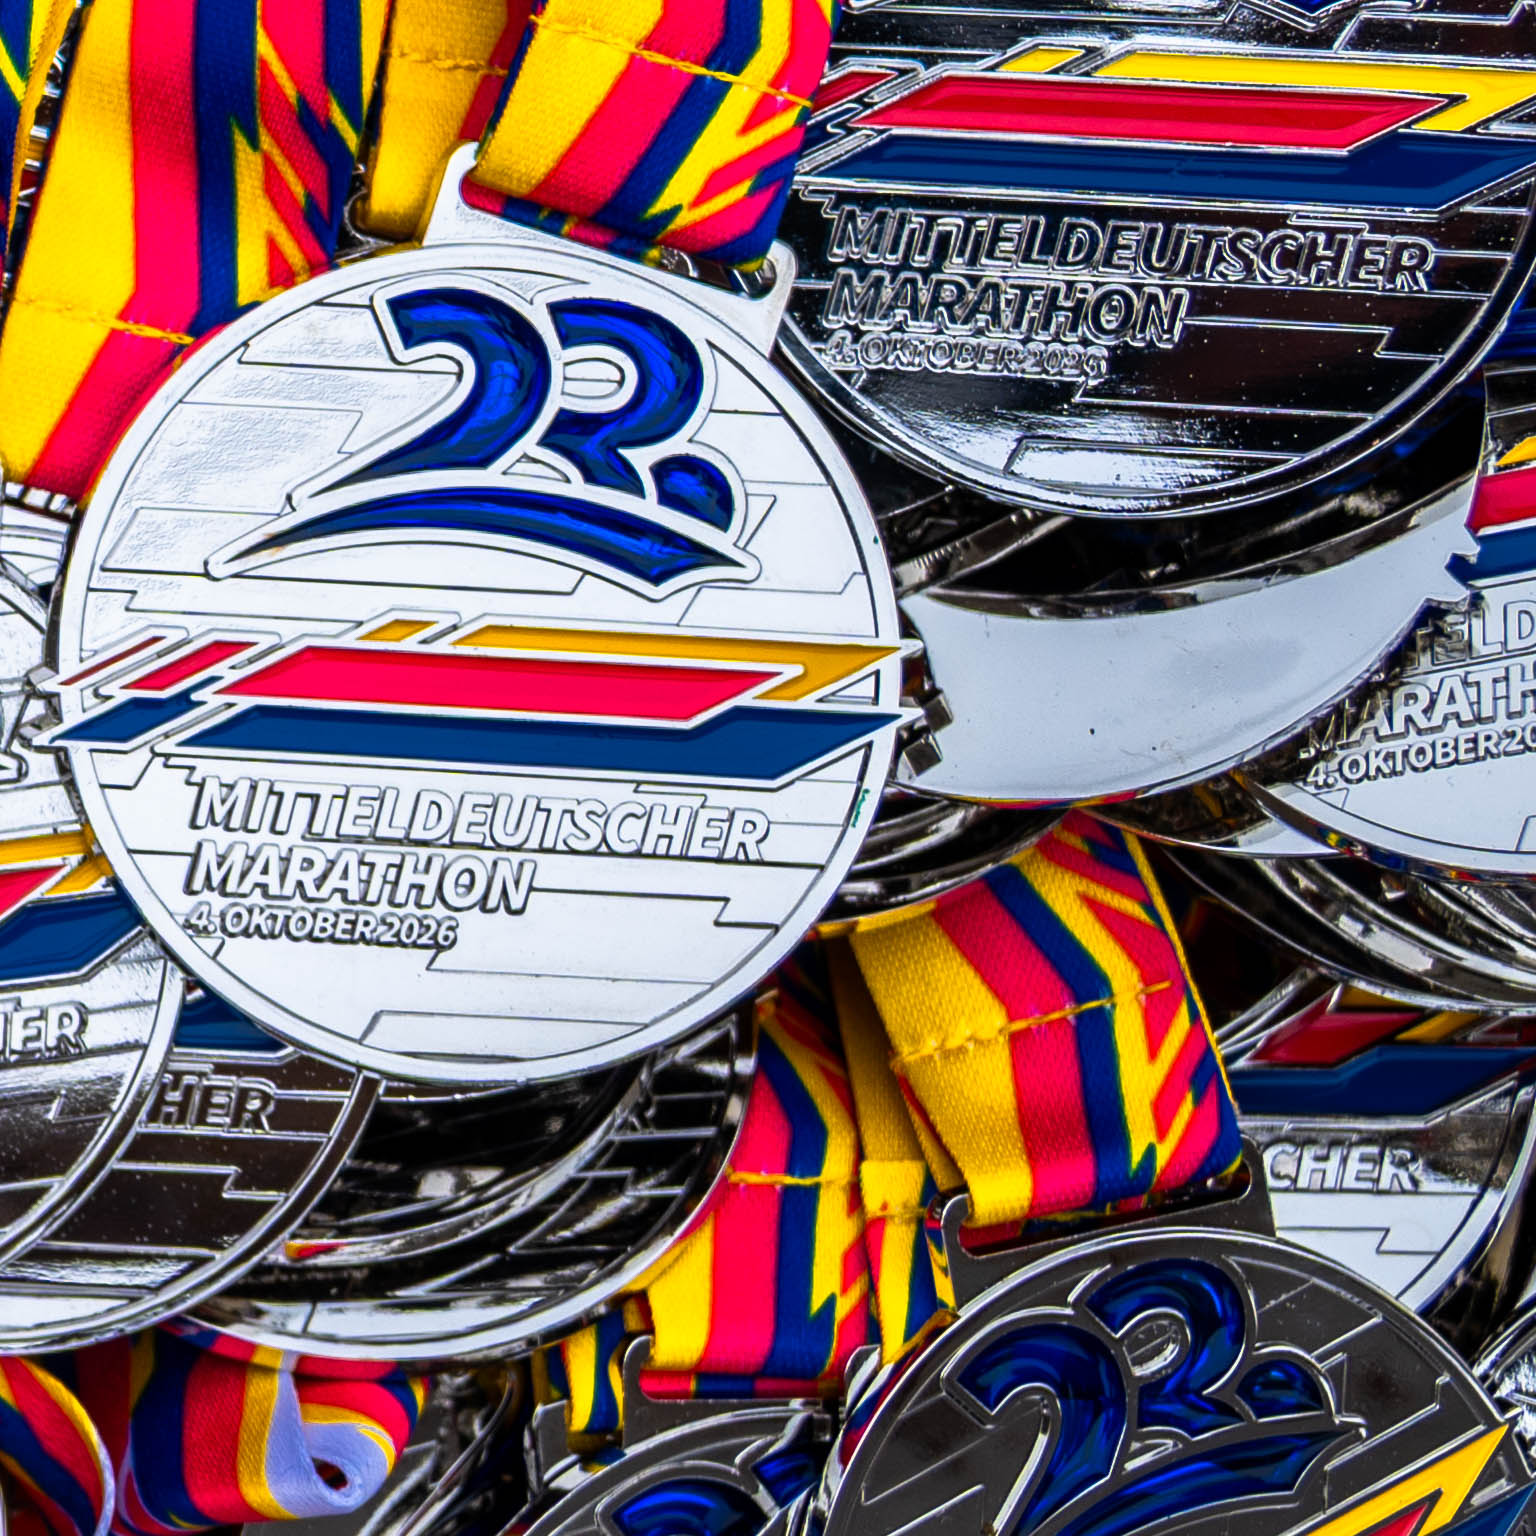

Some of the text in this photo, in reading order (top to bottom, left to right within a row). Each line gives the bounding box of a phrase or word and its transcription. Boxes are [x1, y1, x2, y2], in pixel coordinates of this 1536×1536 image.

[829, 204, 1435, 291] MITTELDEUTSCHER
[824, 267, 1190, 348] MARATHON
[858, 331, 1024, 376] OKTOBER
[1340, 727, 1500, 786] OKTOBER
[188, 775, 771, 862] MITTELDEUTSCHER
[184, 839, 536, 916] MARATHON
[187, 901, 460, 952] 4. OKTOBER 2026
